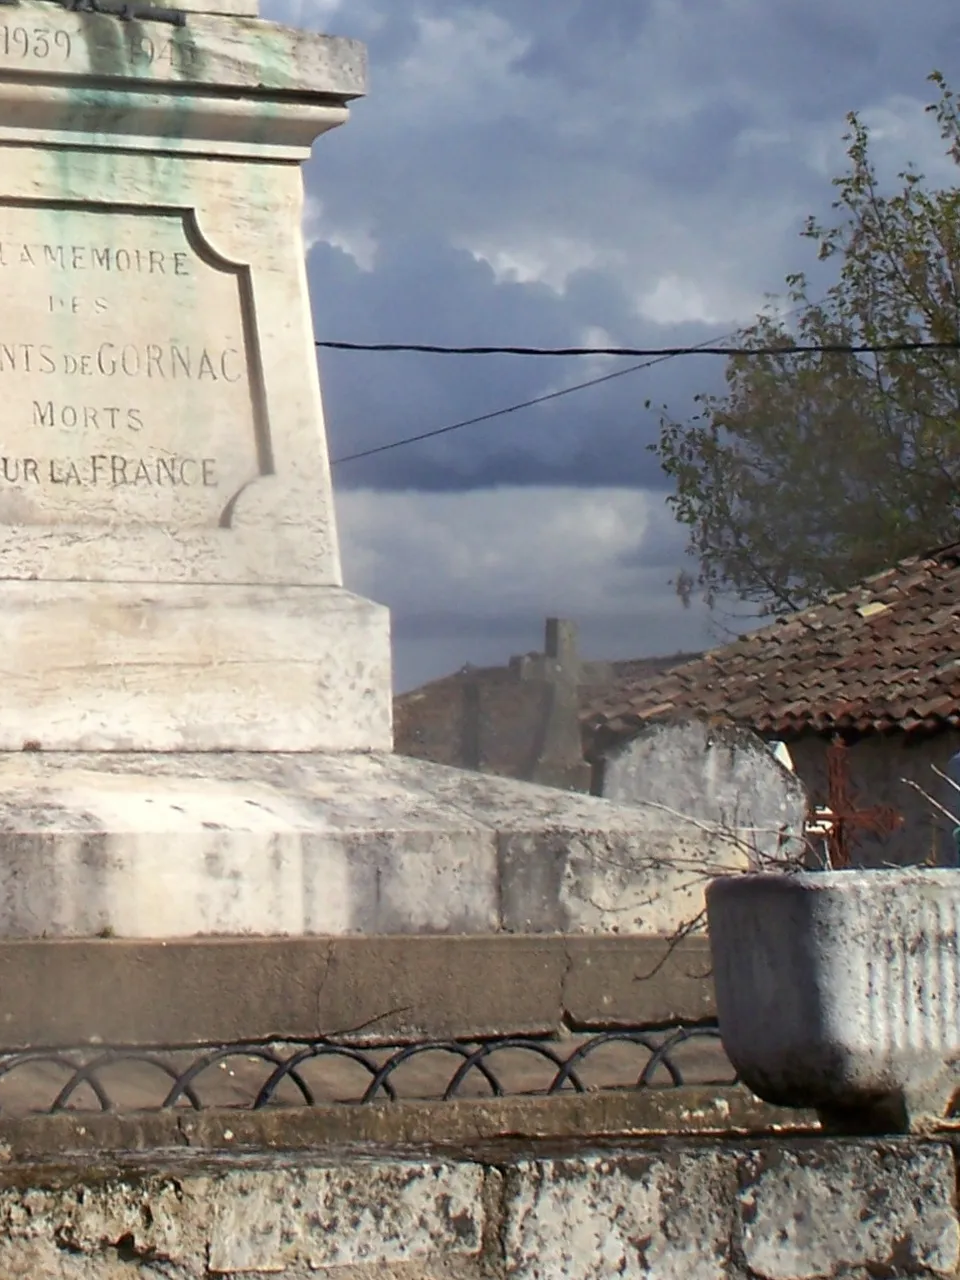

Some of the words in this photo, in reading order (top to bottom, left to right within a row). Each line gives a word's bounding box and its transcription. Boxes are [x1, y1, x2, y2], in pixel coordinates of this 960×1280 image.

[2, 23, 73, 62] 1939
[43, 243, 190, 276] MEMOIRE
[97, 341, 242, 383] GORNAC
[32, 400, 145, 432] MORTS
[49, 459, 82, 486] LA
[89, 454, 220, 488] FRANCE
